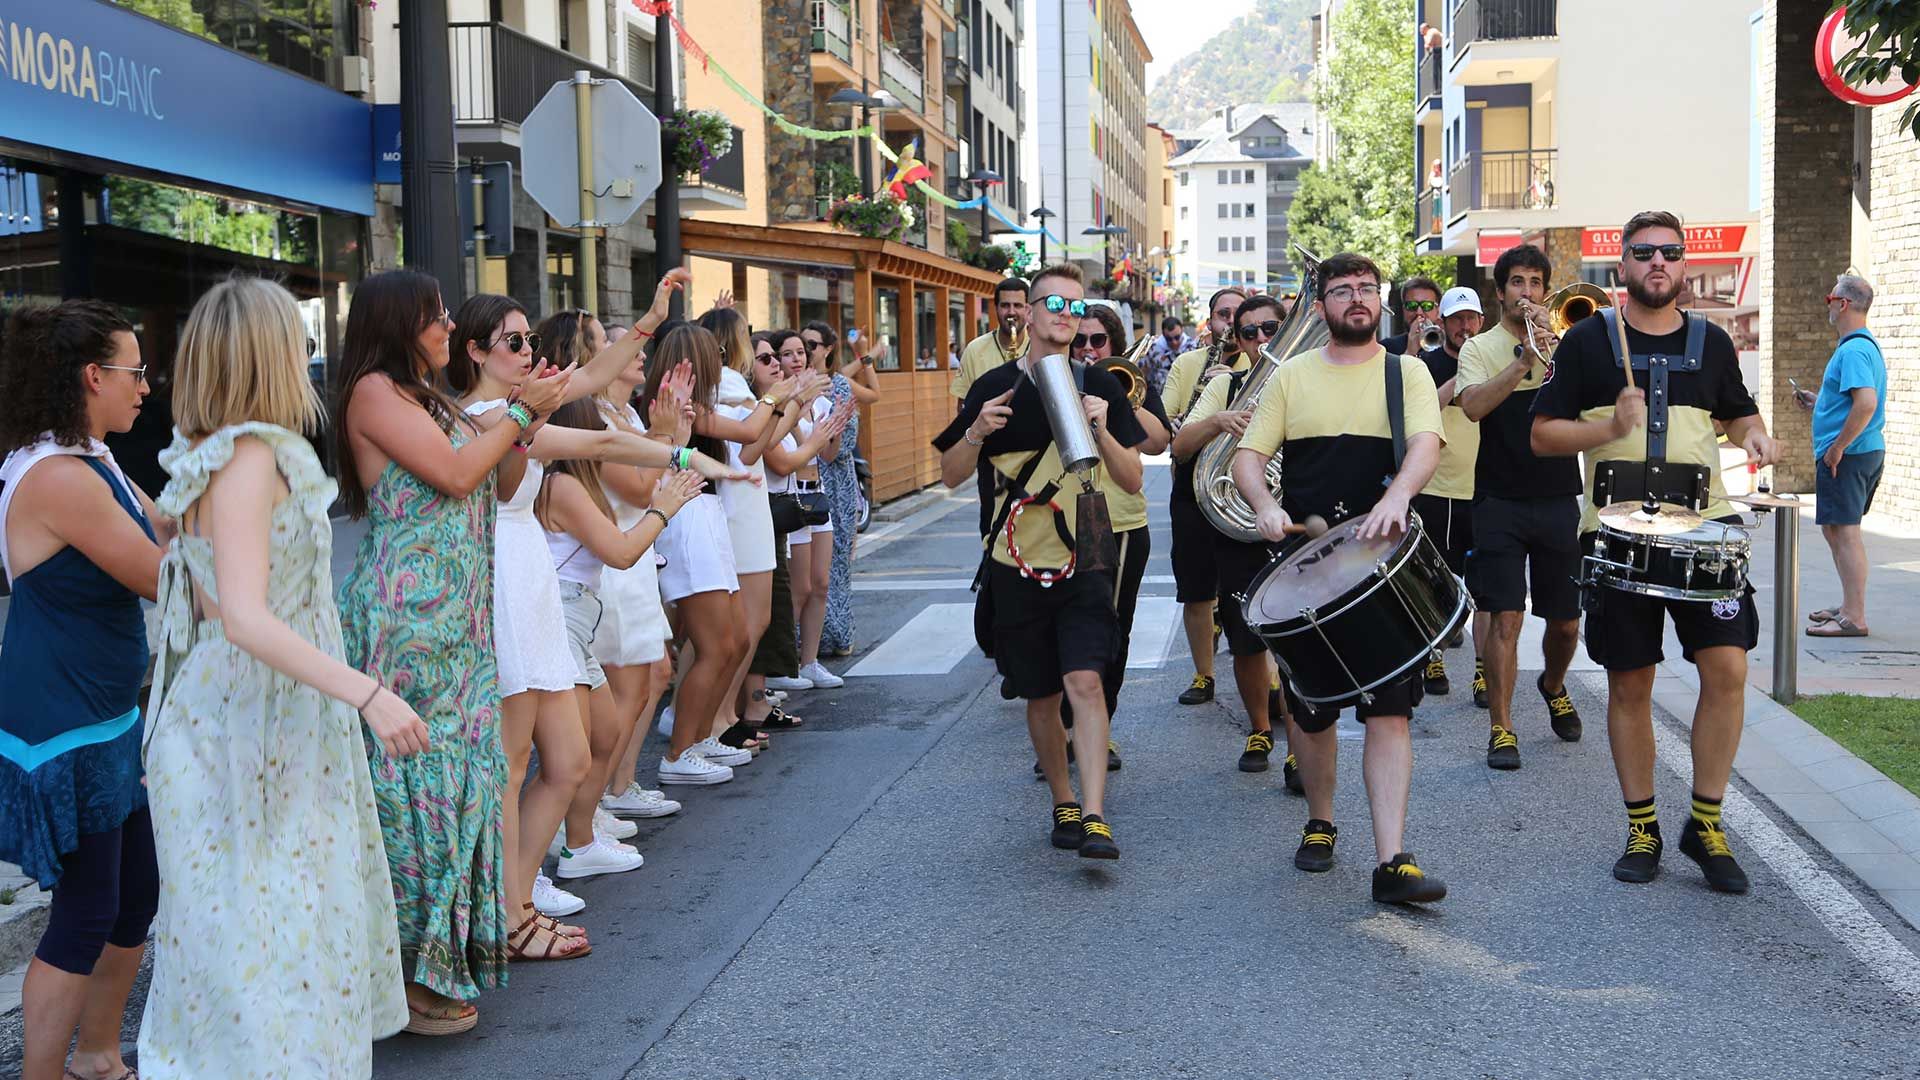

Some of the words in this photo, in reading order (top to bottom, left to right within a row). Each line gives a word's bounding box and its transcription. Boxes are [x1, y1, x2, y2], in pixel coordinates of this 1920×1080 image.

[383, 151, 401, 161] MO
[1592, 232, 1621, 243] GLO
[1683, 228, 1723, 240] ITAT
[1592, 246, 1620, 254] SERV
[1685, 243, 1723, 251] LIARIS
